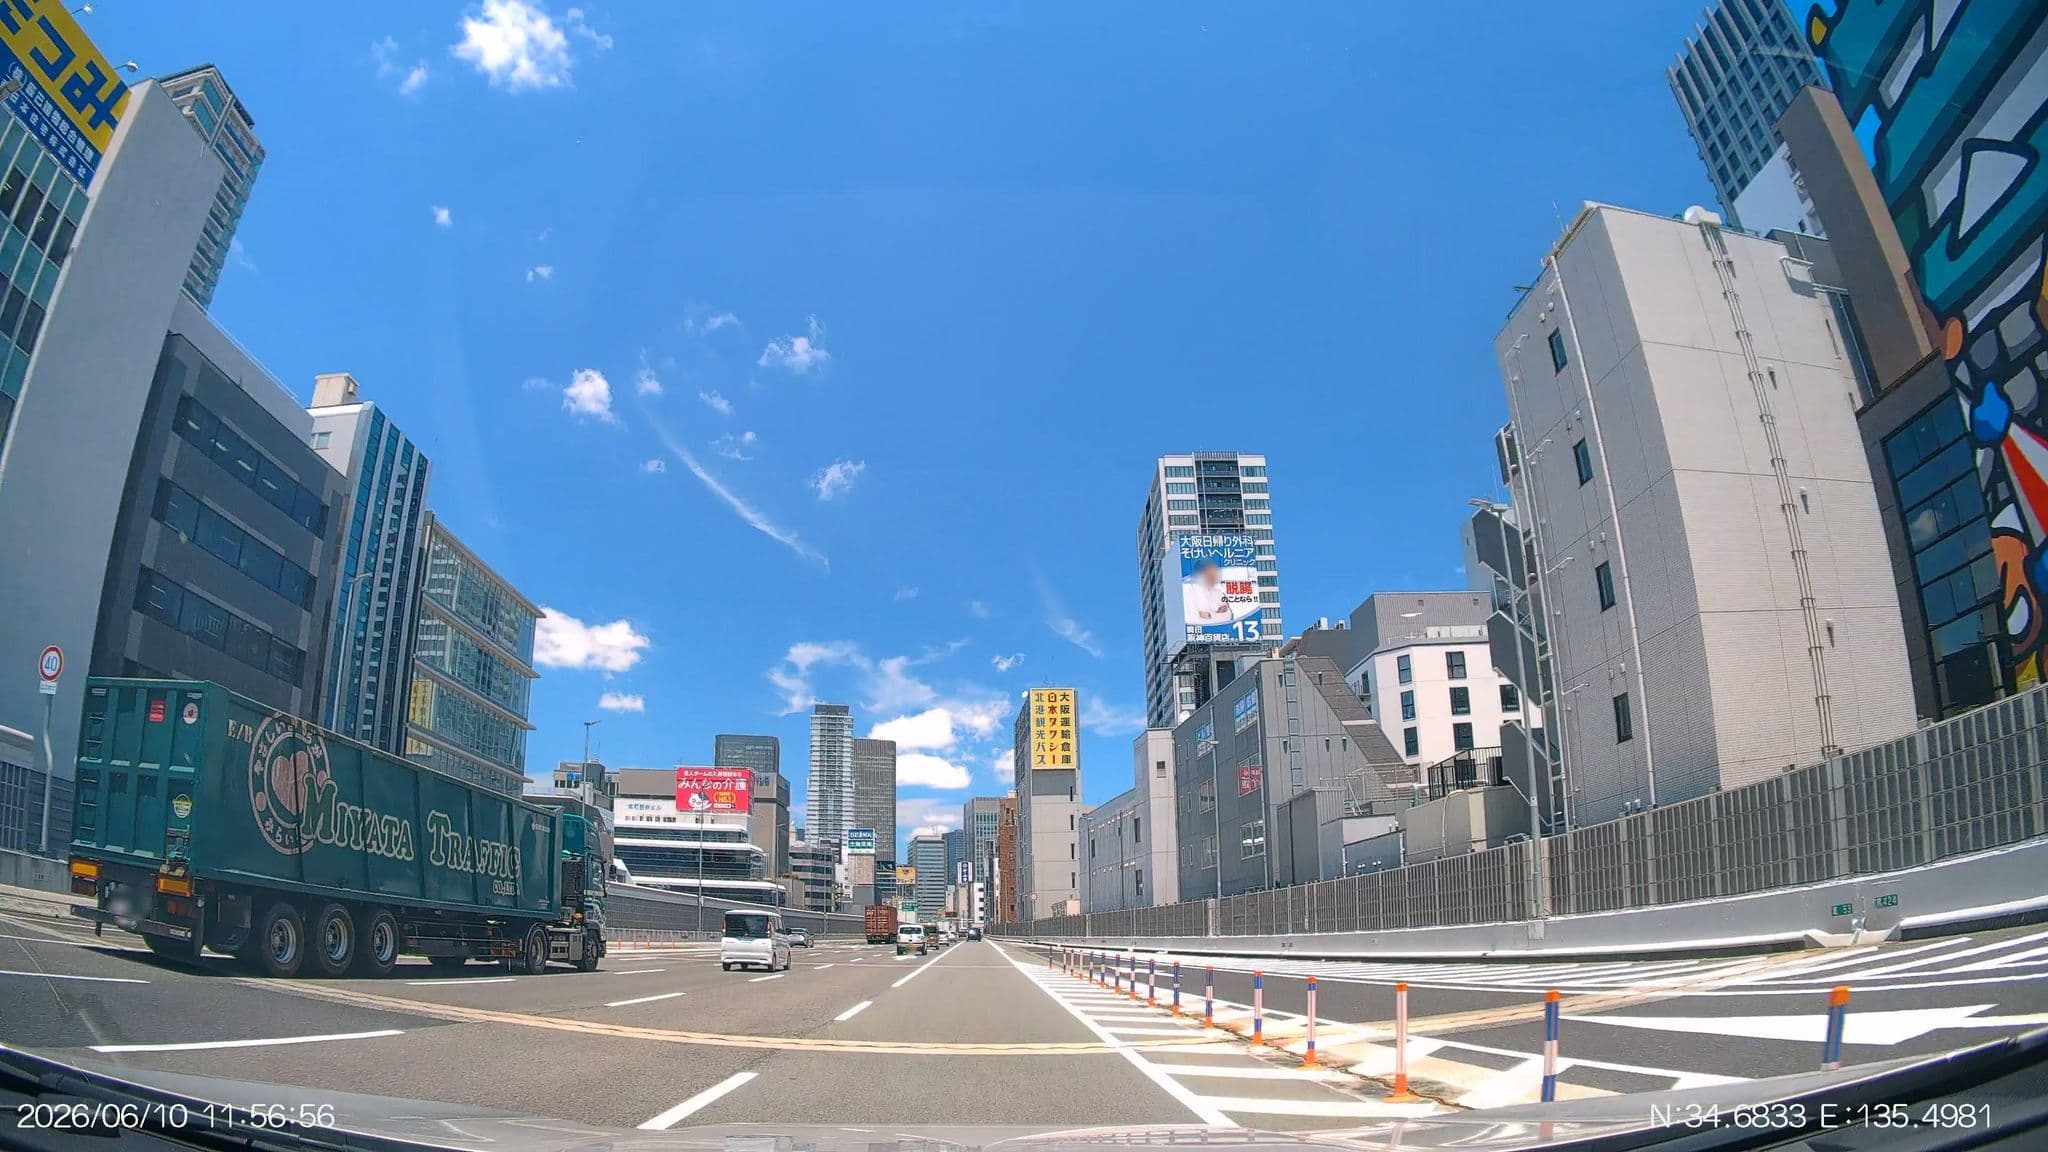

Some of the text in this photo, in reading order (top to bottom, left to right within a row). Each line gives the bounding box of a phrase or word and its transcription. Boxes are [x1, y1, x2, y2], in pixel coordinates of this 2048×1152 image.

[0, 77, 88, 179] 日本住宅株式会社
[1180, 535, 1254, 548] 大阪日帰り外科
[1181, 548, 1254, 558] そけいヘルニア
[44, 656, 58, 672] 40
[1035, 693, 1046, 765] 北港観光バス
[1060, 692, 1072, 764] 大阪運輸倉庫
[678, 777, 747, 791] みんなの介護
[300, 772, 521, 879] MIYATA TRAFFIC
